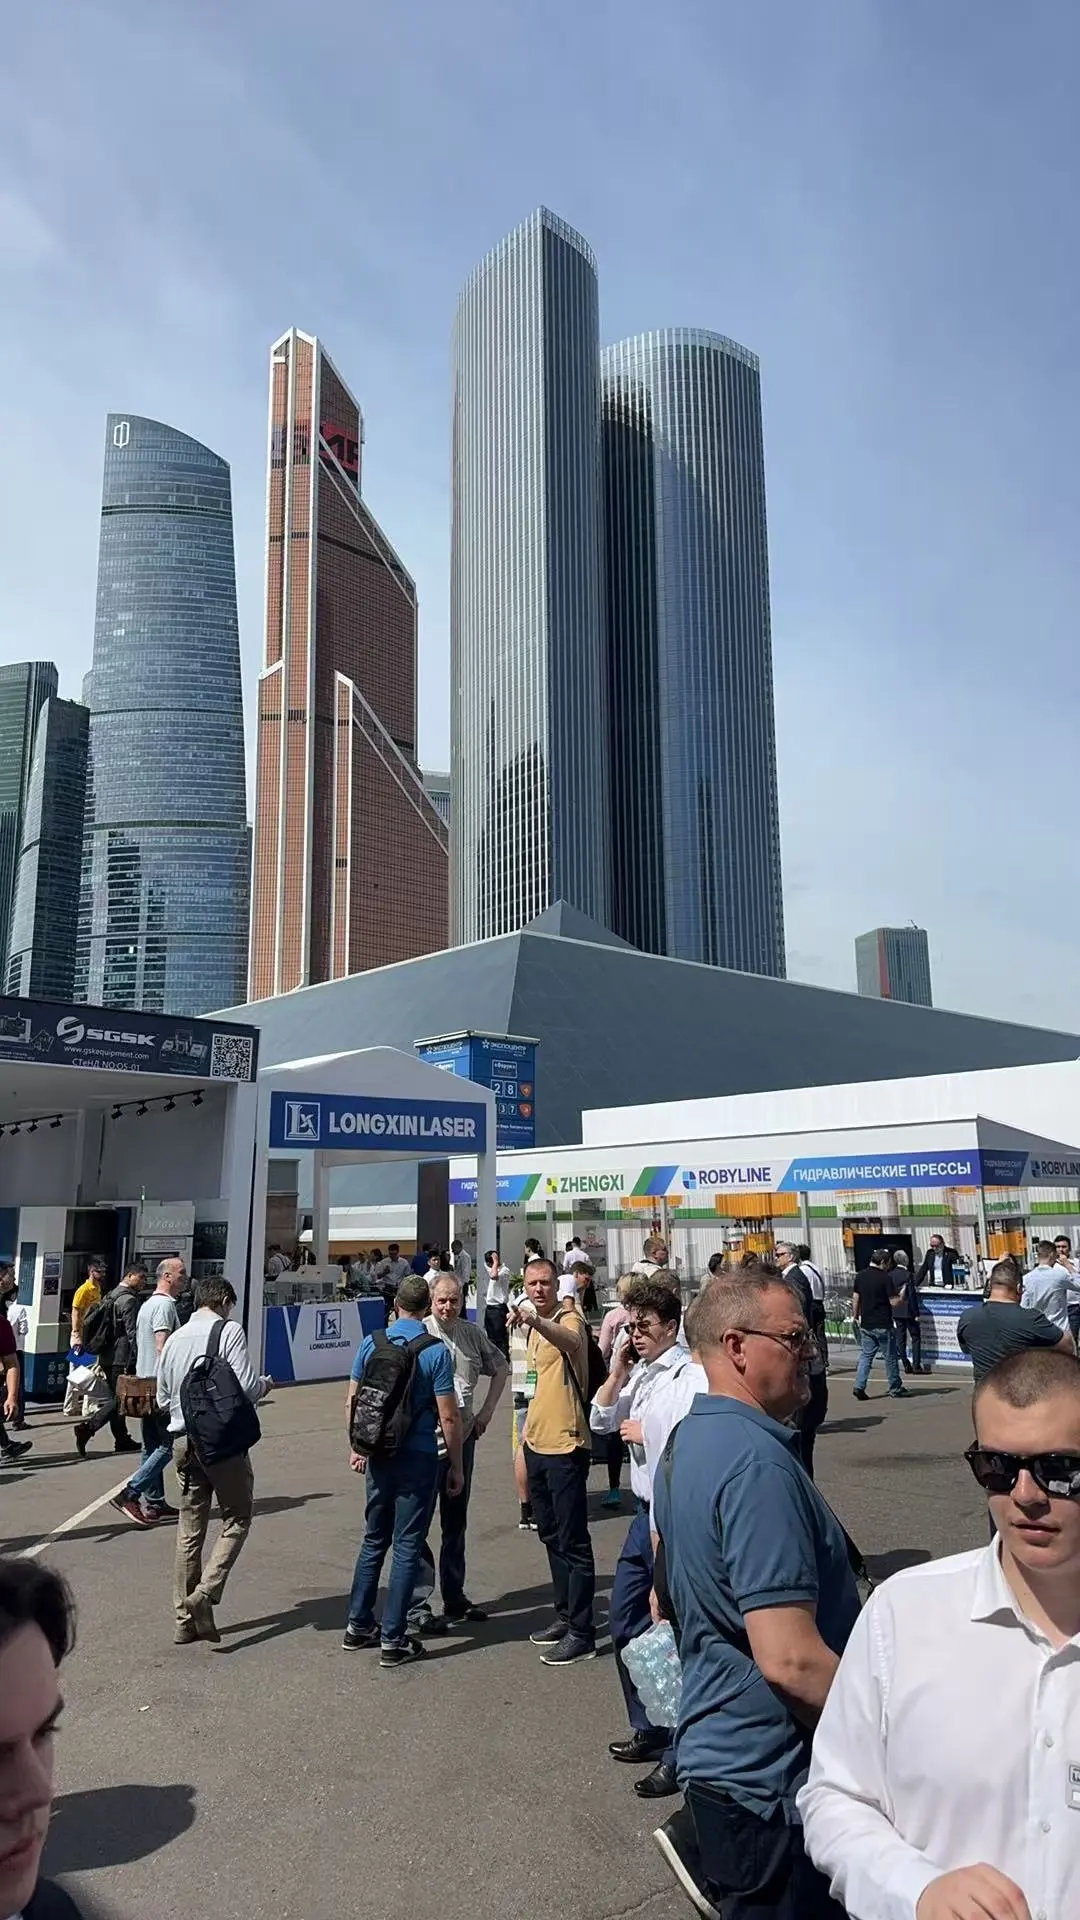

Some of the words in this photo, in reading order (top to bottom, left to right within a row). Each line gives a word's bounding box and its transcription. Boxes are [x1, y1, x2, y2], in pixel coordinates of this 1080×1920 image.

[86, 1027, 156, 1047] SGSK
[494, 1083, 501, 1094] 2
[507, 1085, 514, 1095] 8
[699, 1167, 772, 1185] ROBYLINE
[793, 1164, 907, 1182] ГИДРАВЛИЧЕСКИЕ
[910, 1161, 971, 1177] ПРЕССЫ
[1041, 1160, 1080, 1175] ROBYLIN
[560, 1174, 625, 1193] ZHENGXI
